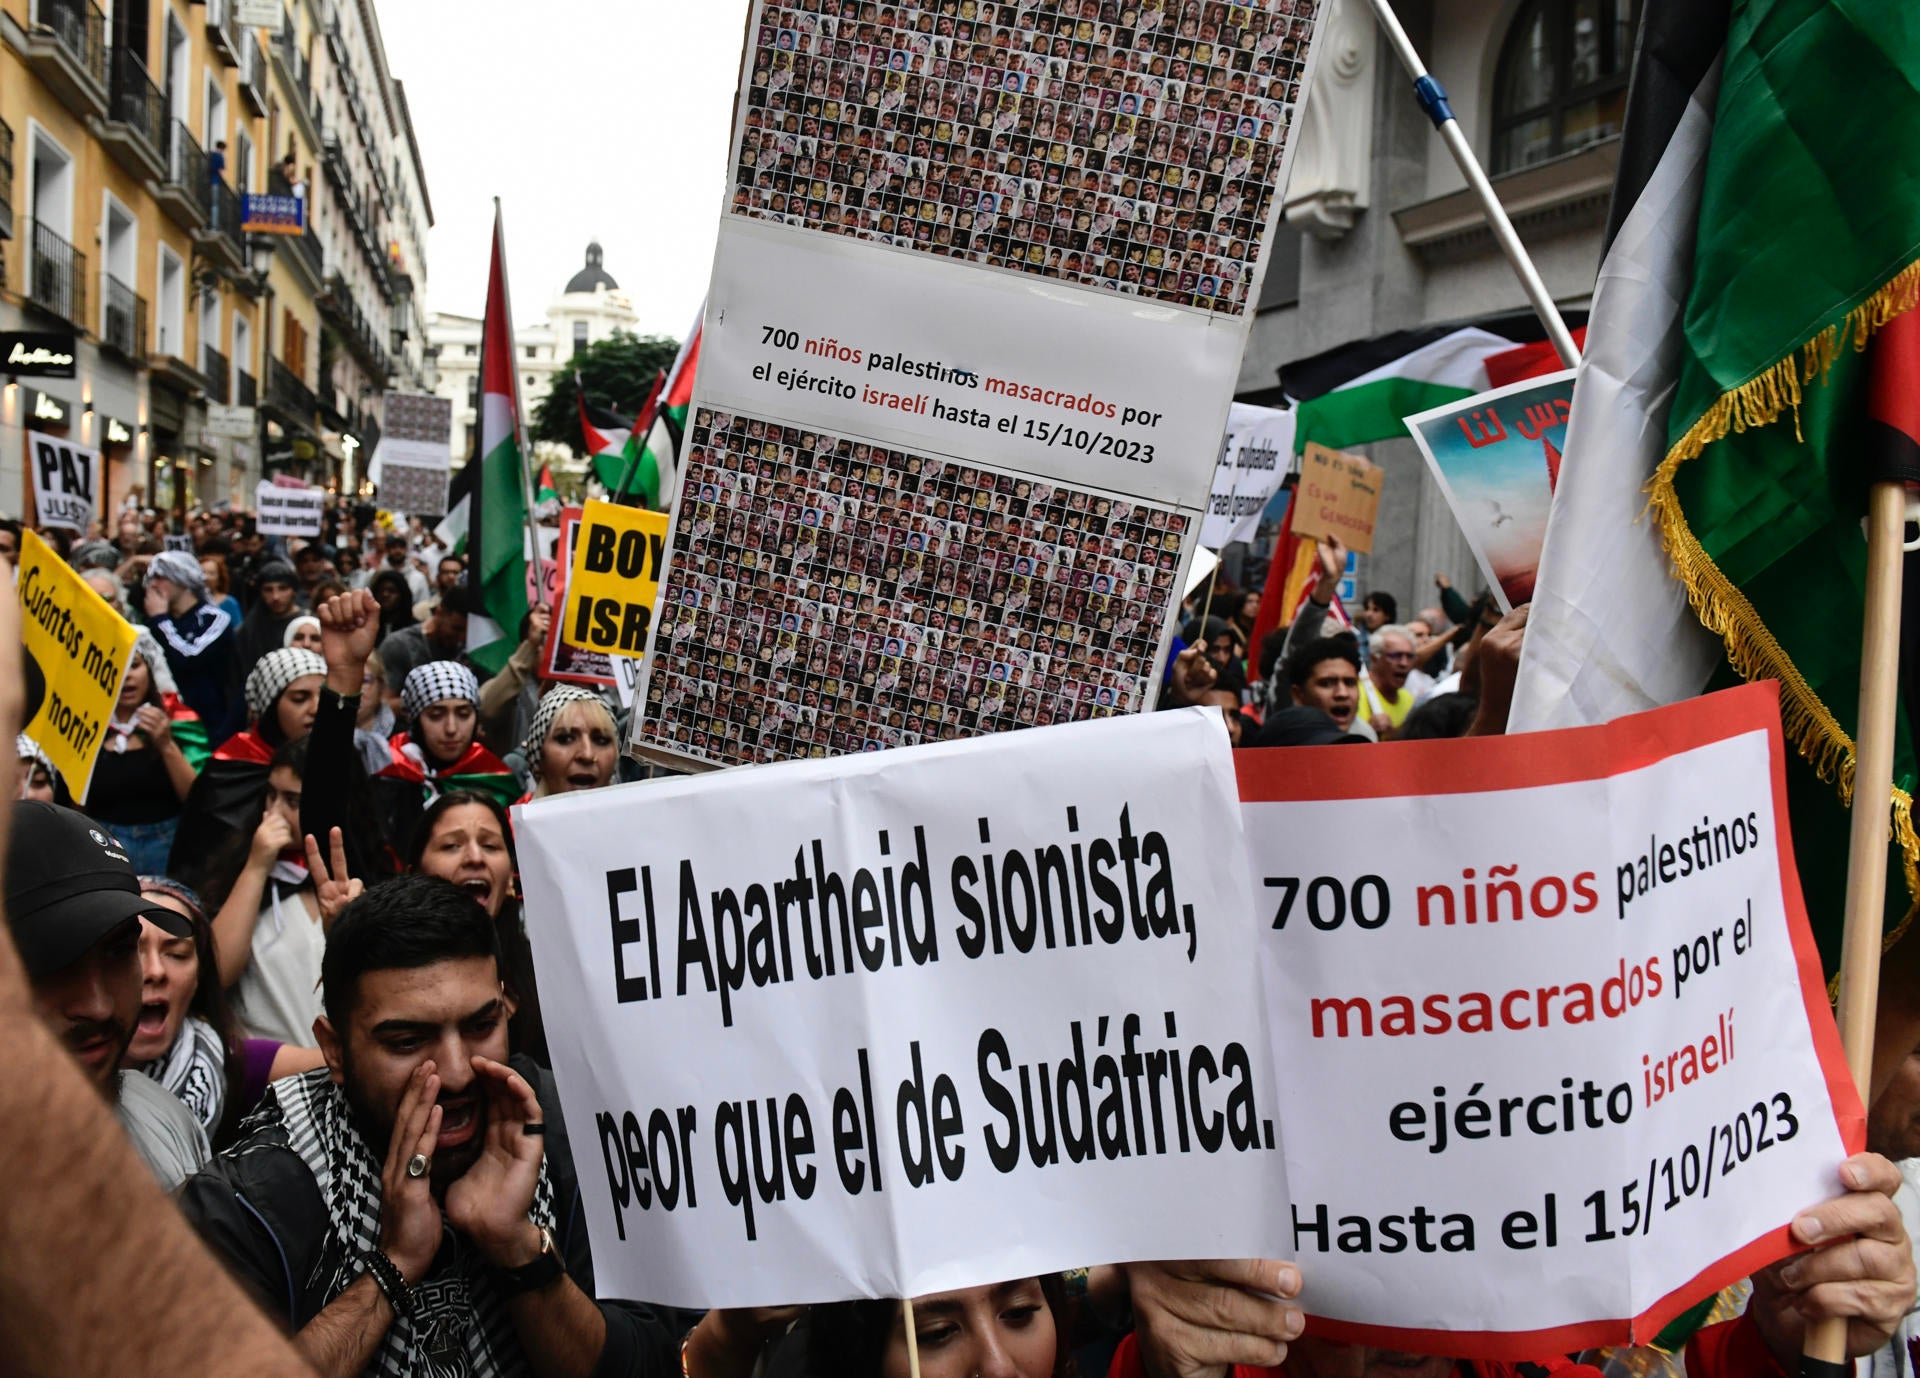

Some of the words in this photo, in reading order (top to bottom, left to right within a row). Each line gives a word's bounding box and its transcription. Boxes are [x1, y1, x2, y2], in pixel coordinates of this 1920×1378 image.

[753, 363, 771, 381] el
[777, 371, 856, 399] ejército
[862, 384, 929, 416] israelí
[933, 399, 990, 428] hasta
[998, 415, 1017, 434] el
[1024, 420, 1154, 463] 15/10/2023
[762, 326, 799, 350] 700
[804, 336, 862, 364] niños
[868, 353, 978, 388] palestinos
[984, 376, 1116, 418] masacrados
[1121, 405, 1164, 429] por
[1457, 408, 1508, 448] لنا
[1237, 437, 1278, 476] culpables
[82, 641, 118, 698] más
[606, 866, 661, 1003] El
[677, 826, 938, 1027] Apartheid
[951, 802, 1196, 962] sionista,
[1264, 875, 1390, 930] 700
[1417, 864, 1598, 926] niños
[1617, 811, 1759, 919] palestinos
[1311, 957, 1662, 1037] masacrados
[1674, 928, 1722, 998] por
[1734, 899, 1751, 955] el
[596, 1105, 697, 1241] peor
[715, 1093, 816, 1241] que
[833, 1048, 882, 1195] el
[897, 1041, 965, 1188] de
[978, 1011, 1275, 1173] Sudáfrica.
[1390, 1078, 1632, 1153] ejército
[1642, 1007, 1735, 1109] israelí
[1291, 1204, 1474, 1253] Hasta
[1502, 1193, 1557, 1249] el
[1583, 1091, 1800, 1243] 15/10/2023
